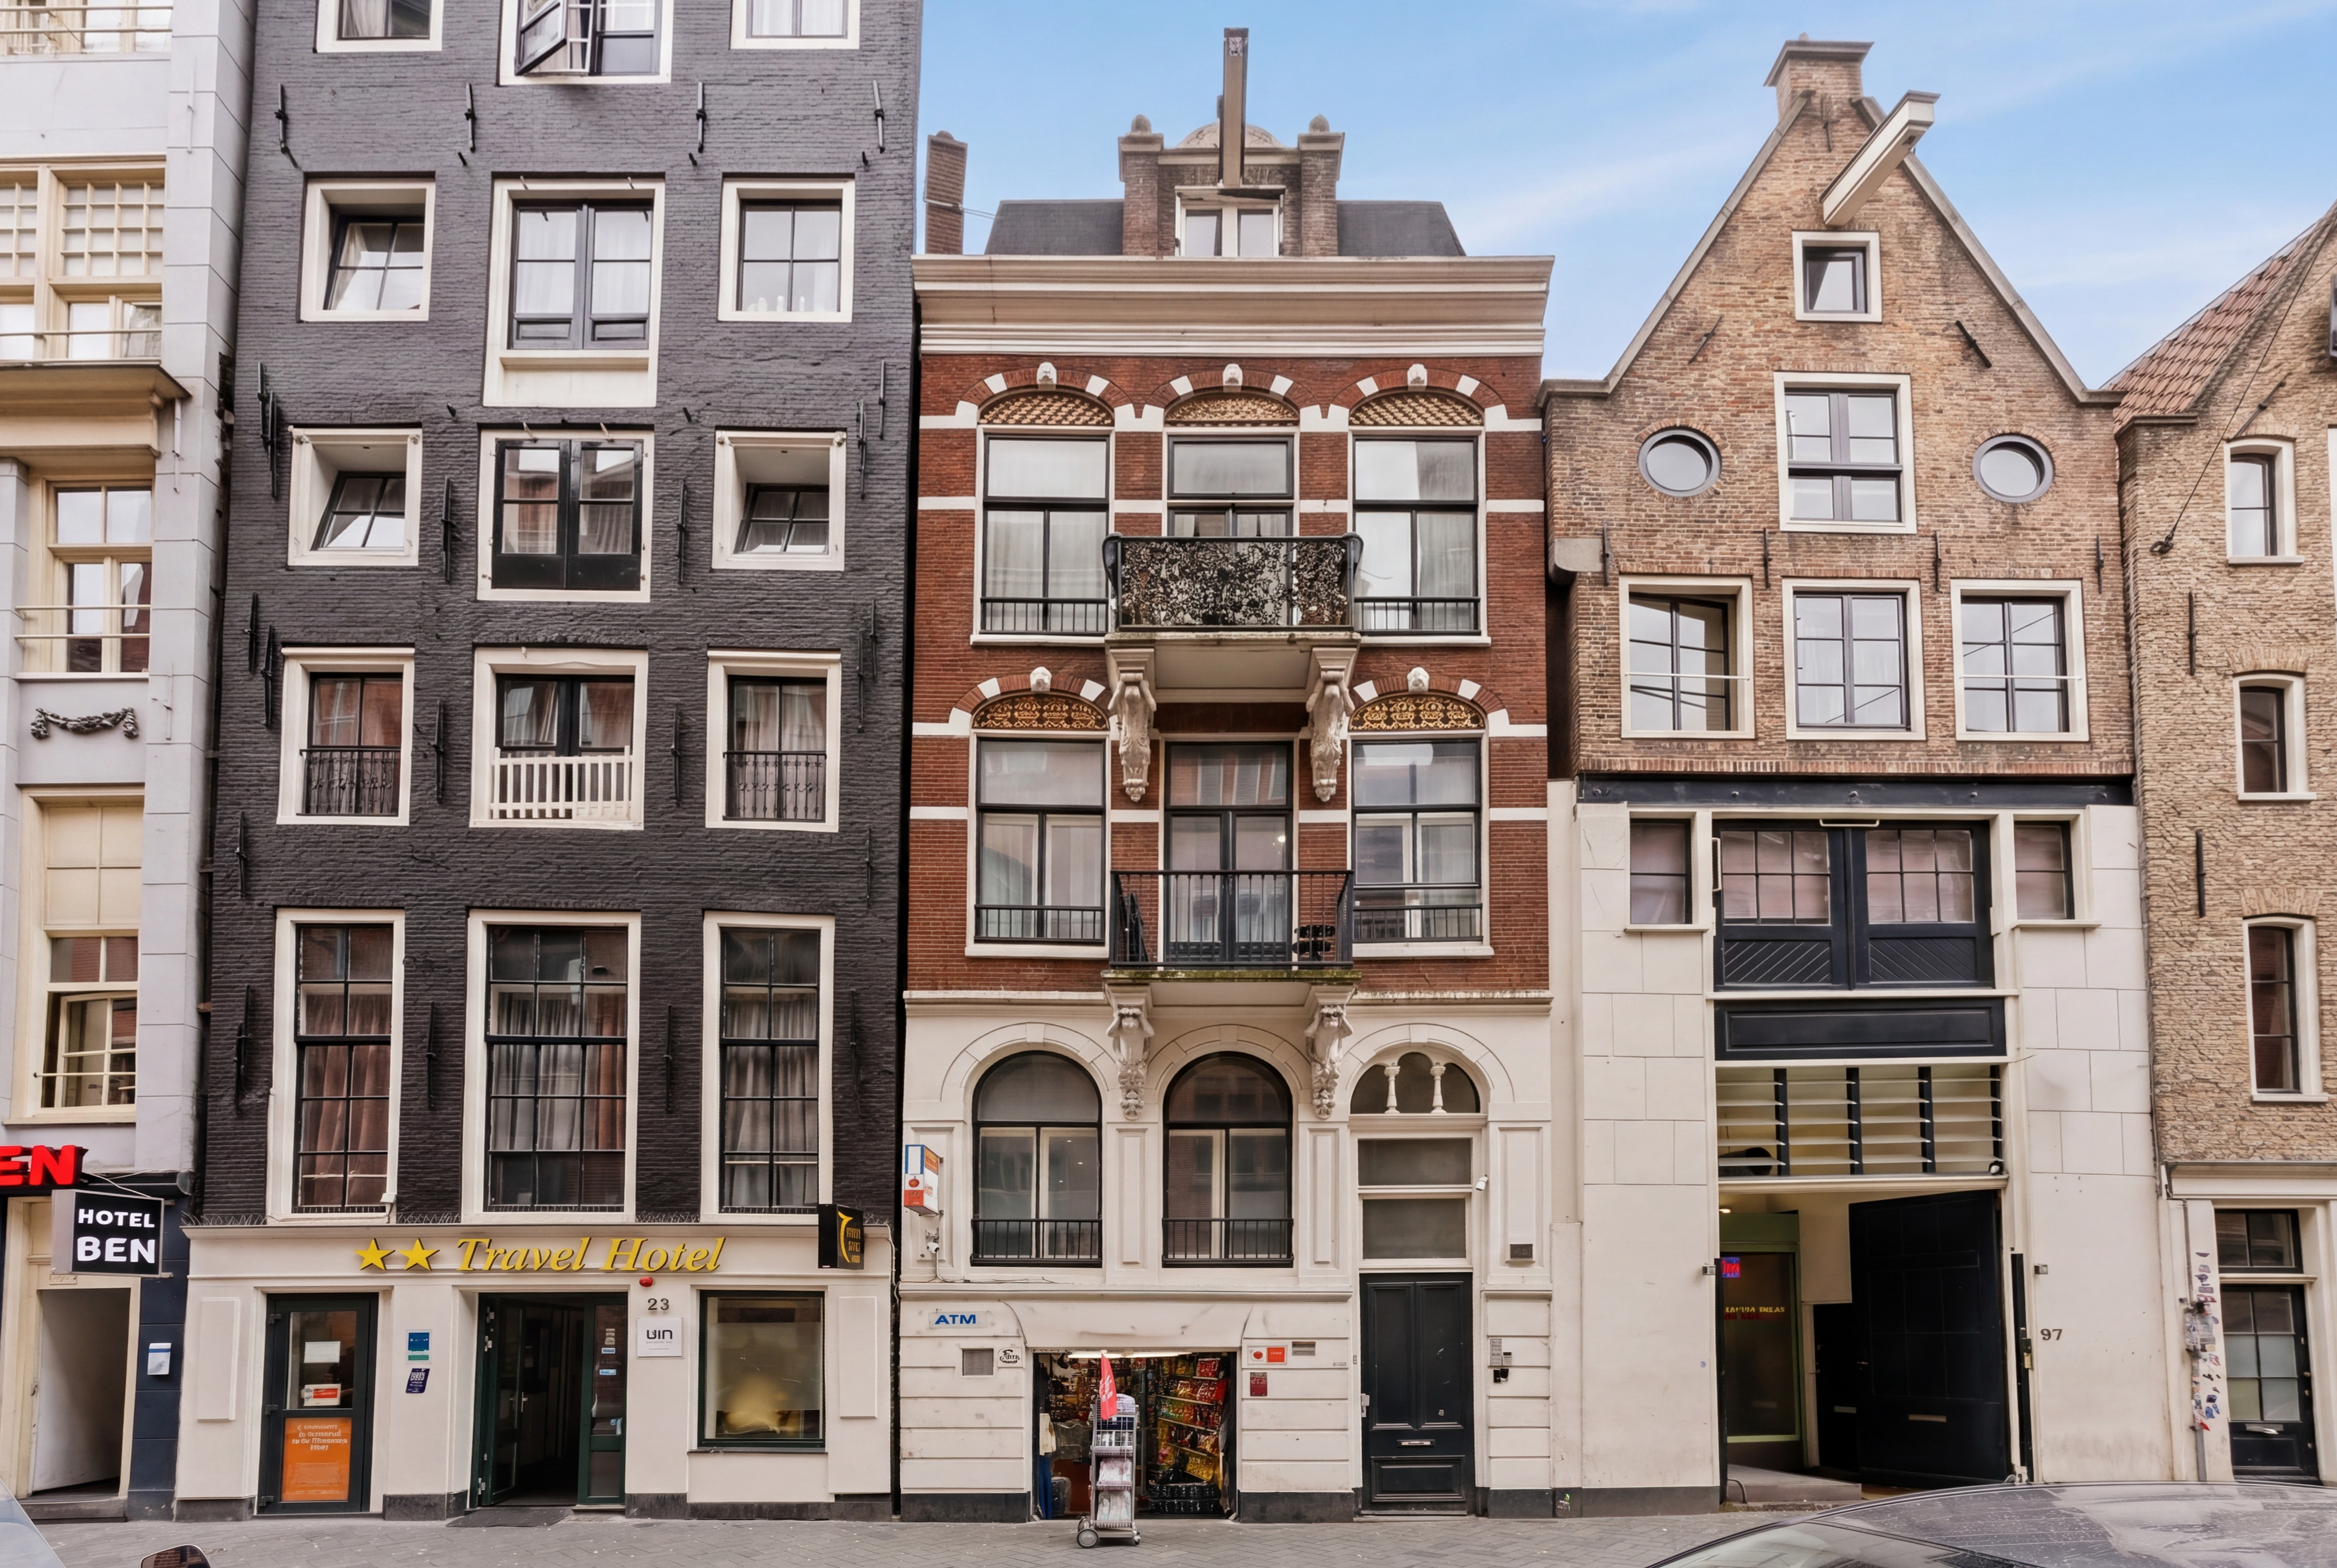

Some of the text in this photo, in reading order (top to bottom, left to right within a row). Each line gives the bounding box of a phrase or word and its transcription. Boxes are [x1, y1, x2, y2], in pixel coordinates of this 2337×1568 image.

[78, 1208, 155, 1228] HOTEL
[77, 1236, 155, 1264] BEN
[456, 1236, 727, 1272] Travel Hotel
[647, 1298, 670, 1311] 23
[934, 1314, 976, 1324] ATM
[2040, 1328, 2062, 1341] 97
